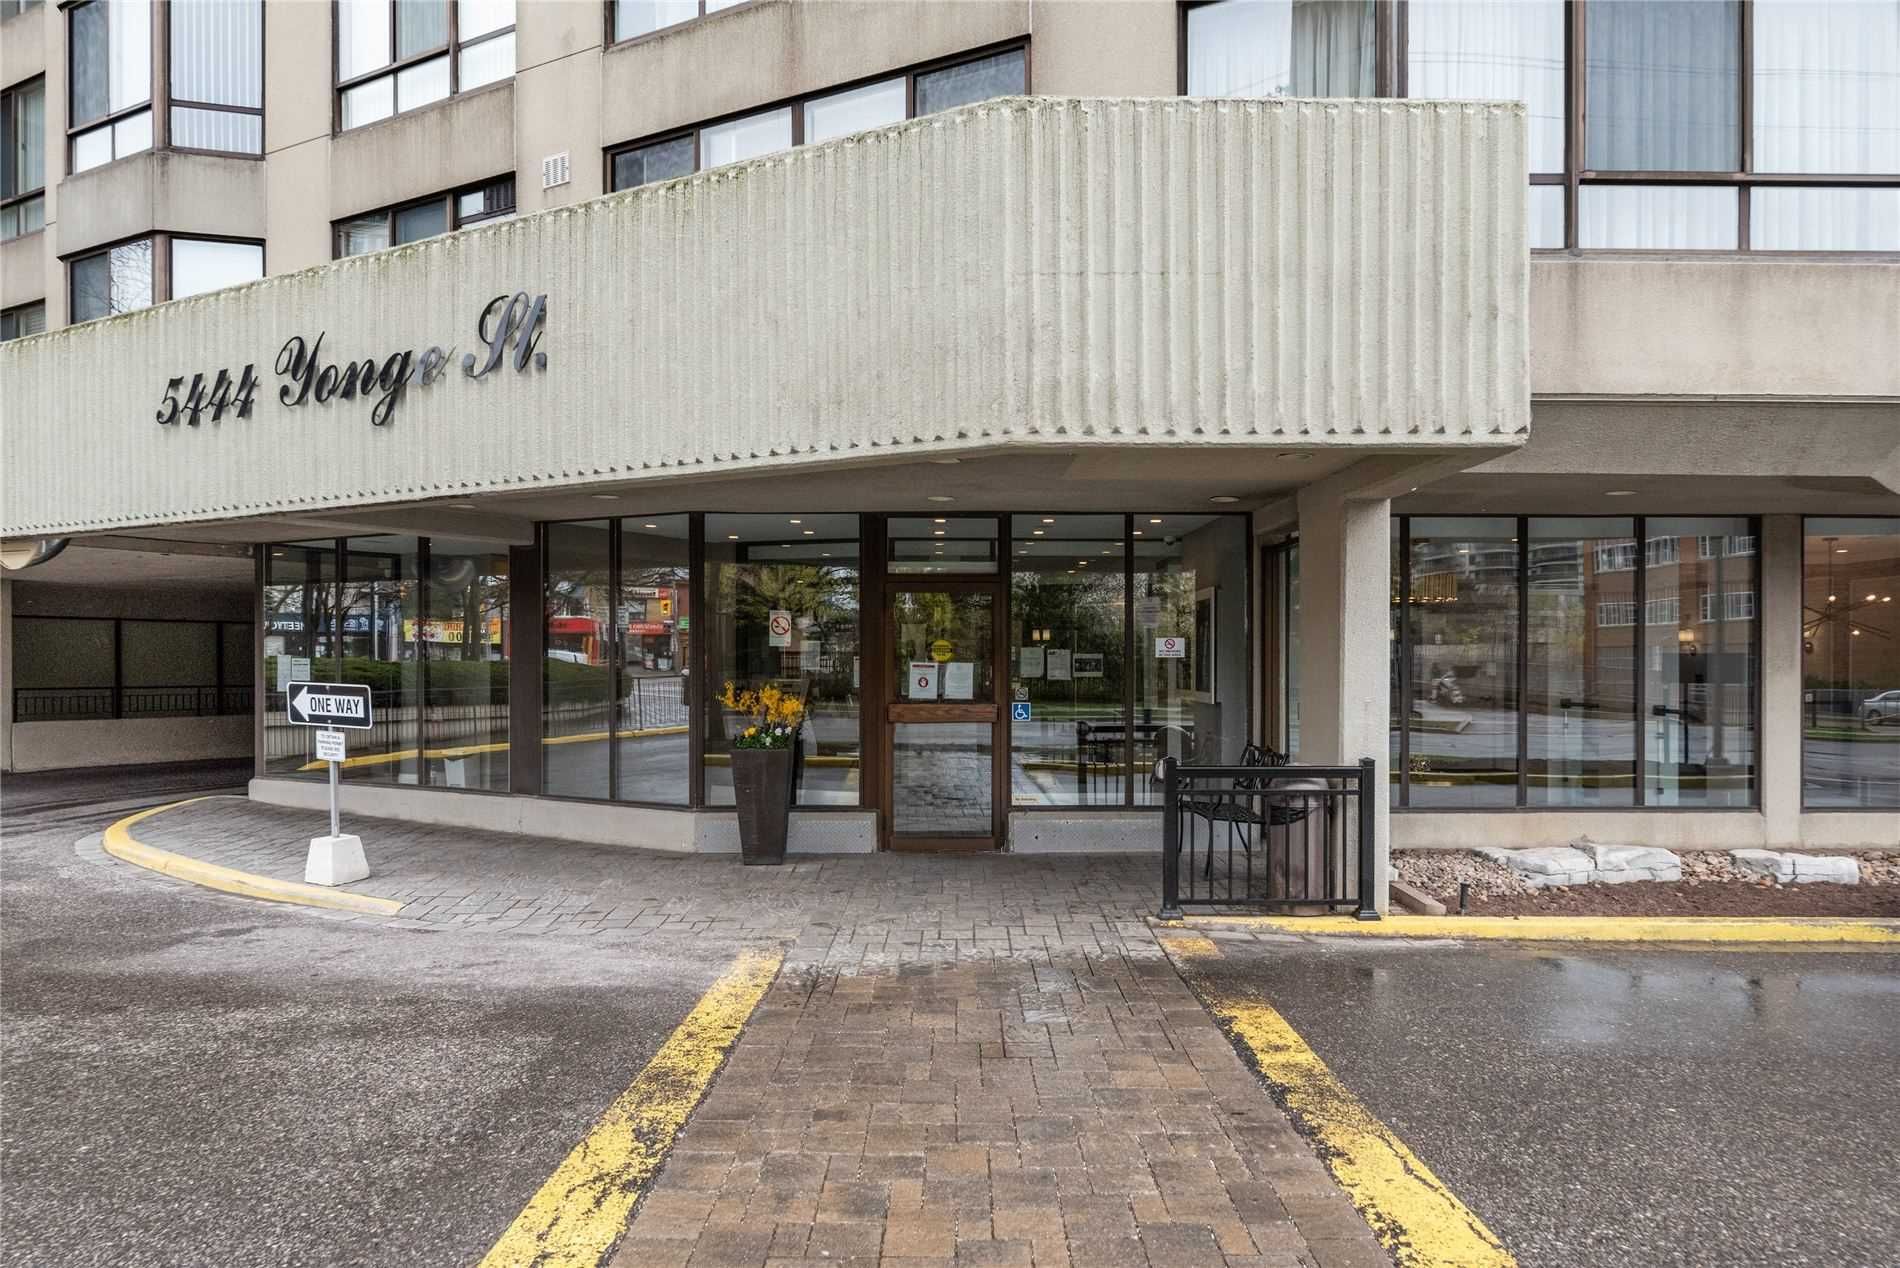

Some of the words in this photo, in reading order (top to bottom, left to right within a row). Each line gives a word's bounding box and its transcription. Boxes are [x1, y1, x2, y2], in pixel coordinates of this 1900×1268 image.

[156, 364, 259, 426] 5444
[275, 331, 456, 427] Yonge
[463, 291, 548, 378] St.
[310, 696, 332, 713] ONE
[334, 697, 360, 714] WAY
